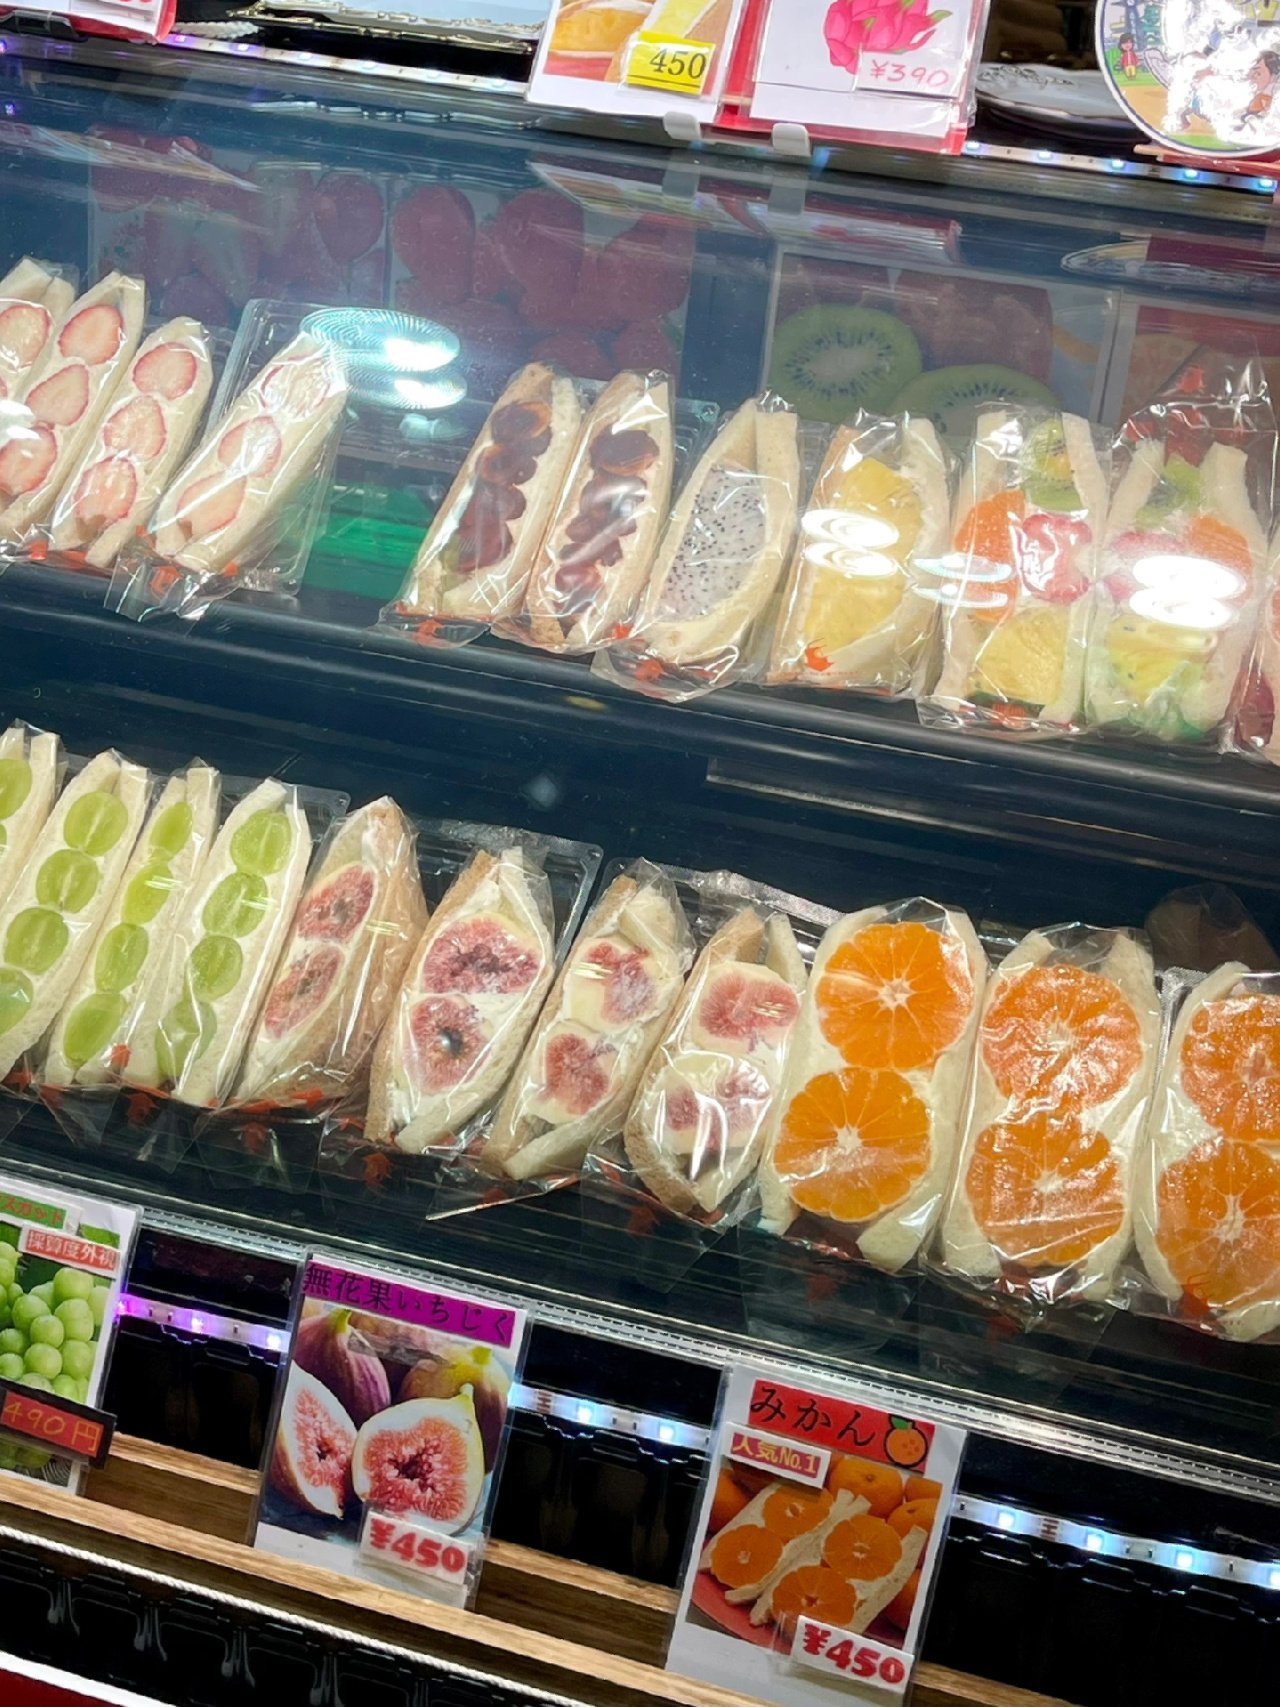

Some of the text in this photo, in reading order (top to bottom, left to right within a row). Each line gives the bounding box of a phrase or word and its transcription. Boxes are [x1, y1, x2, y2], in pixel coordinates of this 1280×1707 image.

[649, 48, 706, 79] 450
[870, 59, 949, 87] ¥390
[0, 1193, 63, 1225] スカット
[303, 1263, 508, 1341] 無花果いちじく
[3, 1402, 101, 1452] 490円
[751, 1387, 876, 1446] みかん
[733, 1434, 817, 1474] 人気No.1
[370, 1518, 465, 1573] ¥450
[803, 1623, 905, 1684] ¥450
